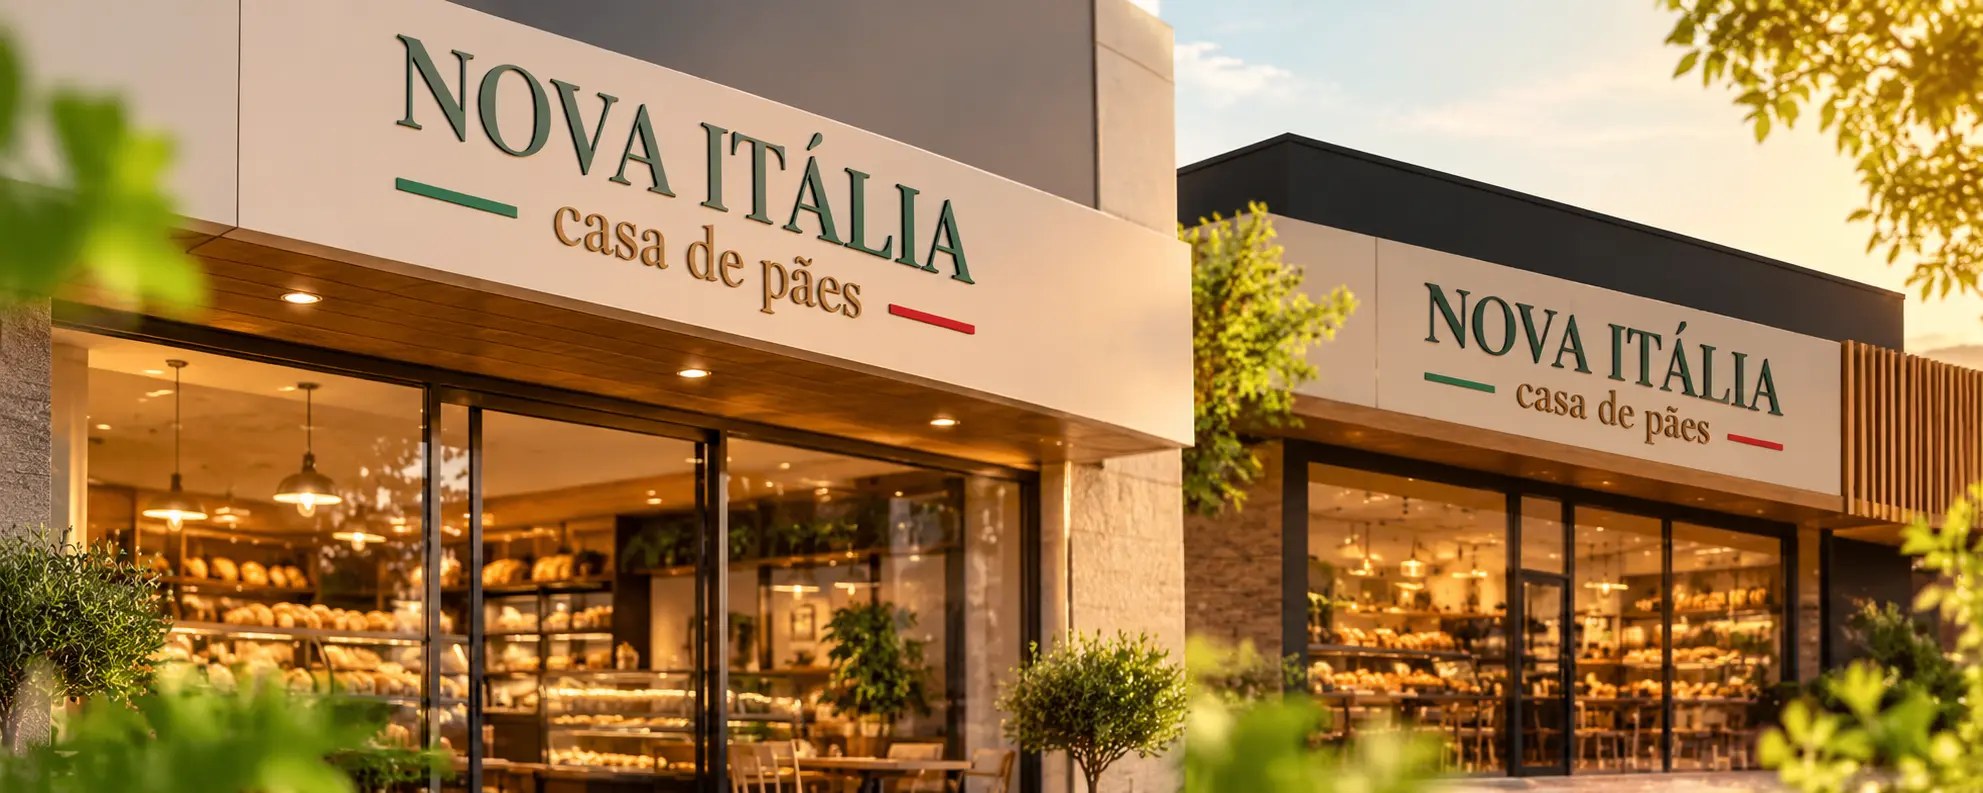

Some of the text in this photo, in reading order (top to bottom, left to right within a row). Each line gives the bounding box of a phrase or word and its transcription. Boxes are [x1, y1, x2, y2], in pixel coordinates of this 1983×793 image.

[396, 33, 975, 285] NOVA ITÁLIA
[553, 205, 863, 318] casa de pães
[1424, 282, 1784, 416] NOVA ITÁLIA
[1516, 382, 1711, 445] casa de pães
